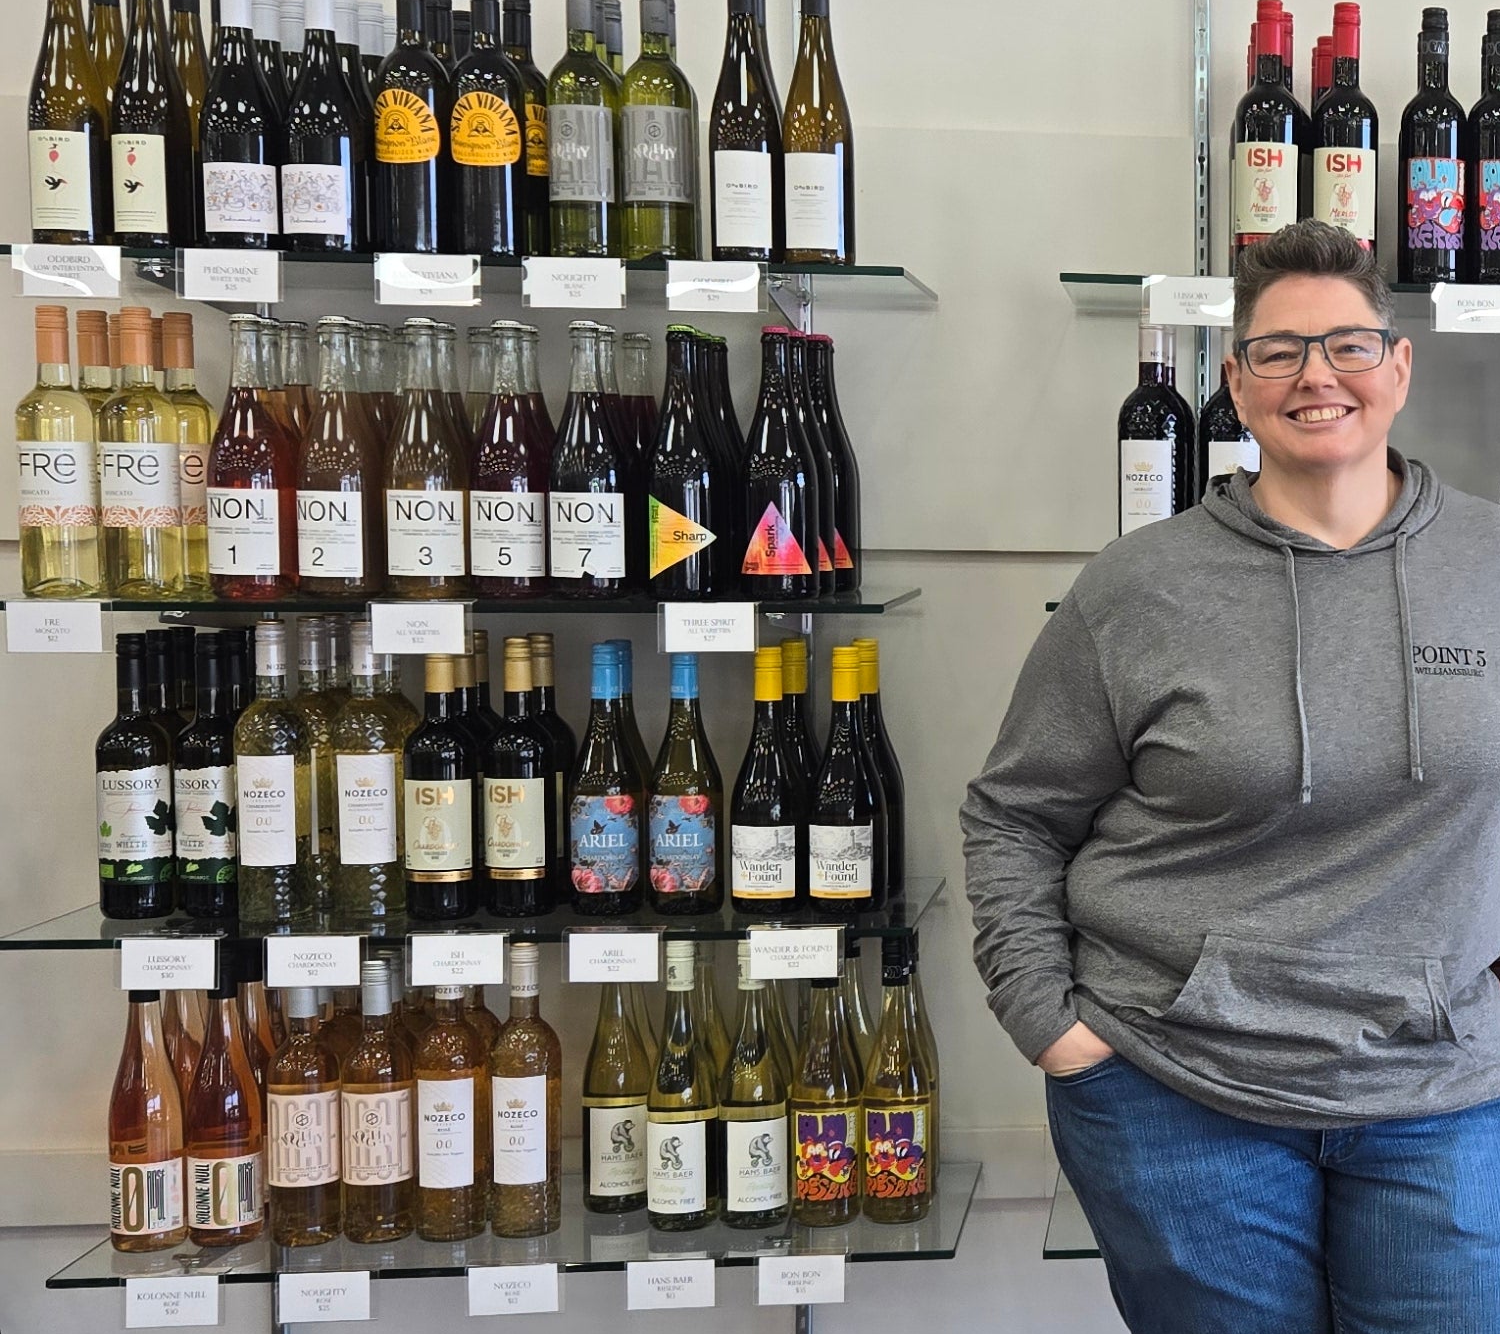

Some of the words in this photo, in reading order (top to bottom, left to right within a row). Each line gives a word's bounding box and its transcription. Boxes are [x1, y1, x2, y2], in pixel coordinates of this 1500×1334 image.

[1247, 148, 1283, 169] ISH
[1326, 153, 1362, 174] ISH
[47, 254, 90, 264] ODDBIRD
[551, 273, 598, 283] NOUGHTY
[1126, 473, 1164, 482] NOZECO
[209, 497, 265, 520] NON
[299, 501, 348, 522] NON
[395, 500, 455, 523] NON
[477, 501, 535, 524] NON
[557, 502, 615, 524] NON
[672, 529, 708, 544] Sharp
[765, 524, 776, 558] Spark
[227, 544, 238, 566] 1
[311, 547, 325, 567] 2
[418, 546, 433, 566] 3
[497, 546, 512, 566] 5
[578, 548, 593, 568] 7
[44, 618, 60, 626] FRE
[406, 620, 429, 628] NON
[1412, 645, 1473, 666] POINT
[1477, 650, 1487, 667] 5
[1415, 666, 1485, 678] WILLIAMSBURG
[101, 778, 163, 792] LUSSORY
[243, 789, 286, 799] NOZECO
[344, 788, 388, 799] NOZECO
[415, 786, 455, 806] ISH
[489, 784, 526, 804] ISH
[579, 833, 628, 849] ARIEL
[655, 833, 704, 849] ARIEL
[739, 860, 781, 874] Wander
[816, 860, 857, 874] Wander
[423, 1112, 466, 1123] NOZECO
[497, 1109, 539, 1120] NOZECO
[601, 1153, 623, 1162] HANS
[110, 1167, 121, 1191] NULL
[200, 1163, 211, 1185] NULL
[653, 1170, 668, 1179] HANS
[670, 1169, 694, 1179] BAER
[739, 1168, 761, 1178] HANS
[763, 1166, 782, 1177] BAER
[599, 1180, 631, 1189] ALCOHOL
[196, 1184, 210, 1225] KOLONNE
[652, 1197, 679, 1207] ALCOHOL
[679, 1196, 697, 1206] FREE
[737, 1194, 769, 1205] ALCOHOL
[110, 1191, 122, 1231] KOLONNE
[781, 1269, 800, 1280] BON
[801, 1269, 822, 1279] BON
[300, 1287, 348, 1298] NOUGHTY
[493, 1280, 532, 1291] NOZECO
[137, 1291, 181, 1301] KOLONNE
